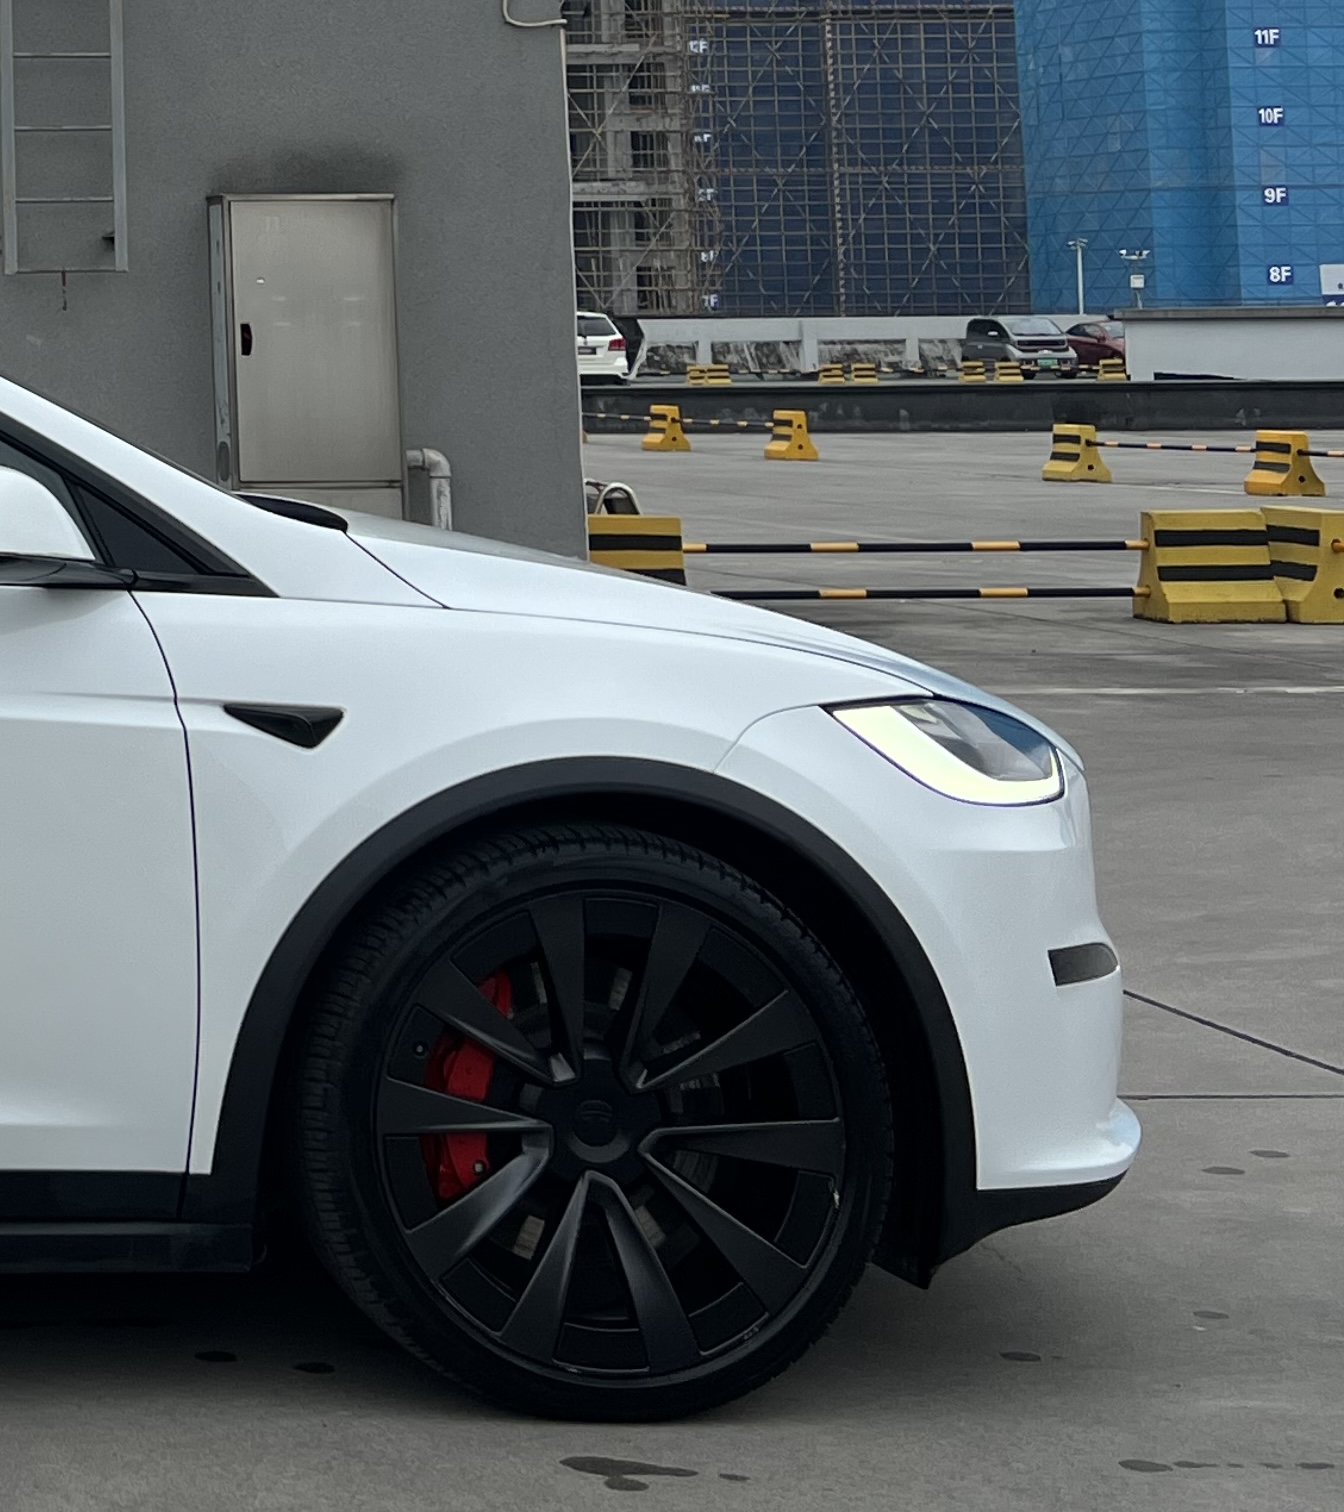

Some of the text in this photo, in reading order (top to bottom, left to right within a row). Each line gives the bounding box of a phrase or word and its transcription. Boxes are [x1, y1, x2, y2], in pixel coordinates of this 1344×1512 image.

[1254, 29, 1279, 44] 11F
[1258, 108, 1283, 123] 10F
[1264, 188, 1286, 203] 9F
[1269, 266, 1291, 282] 8F
